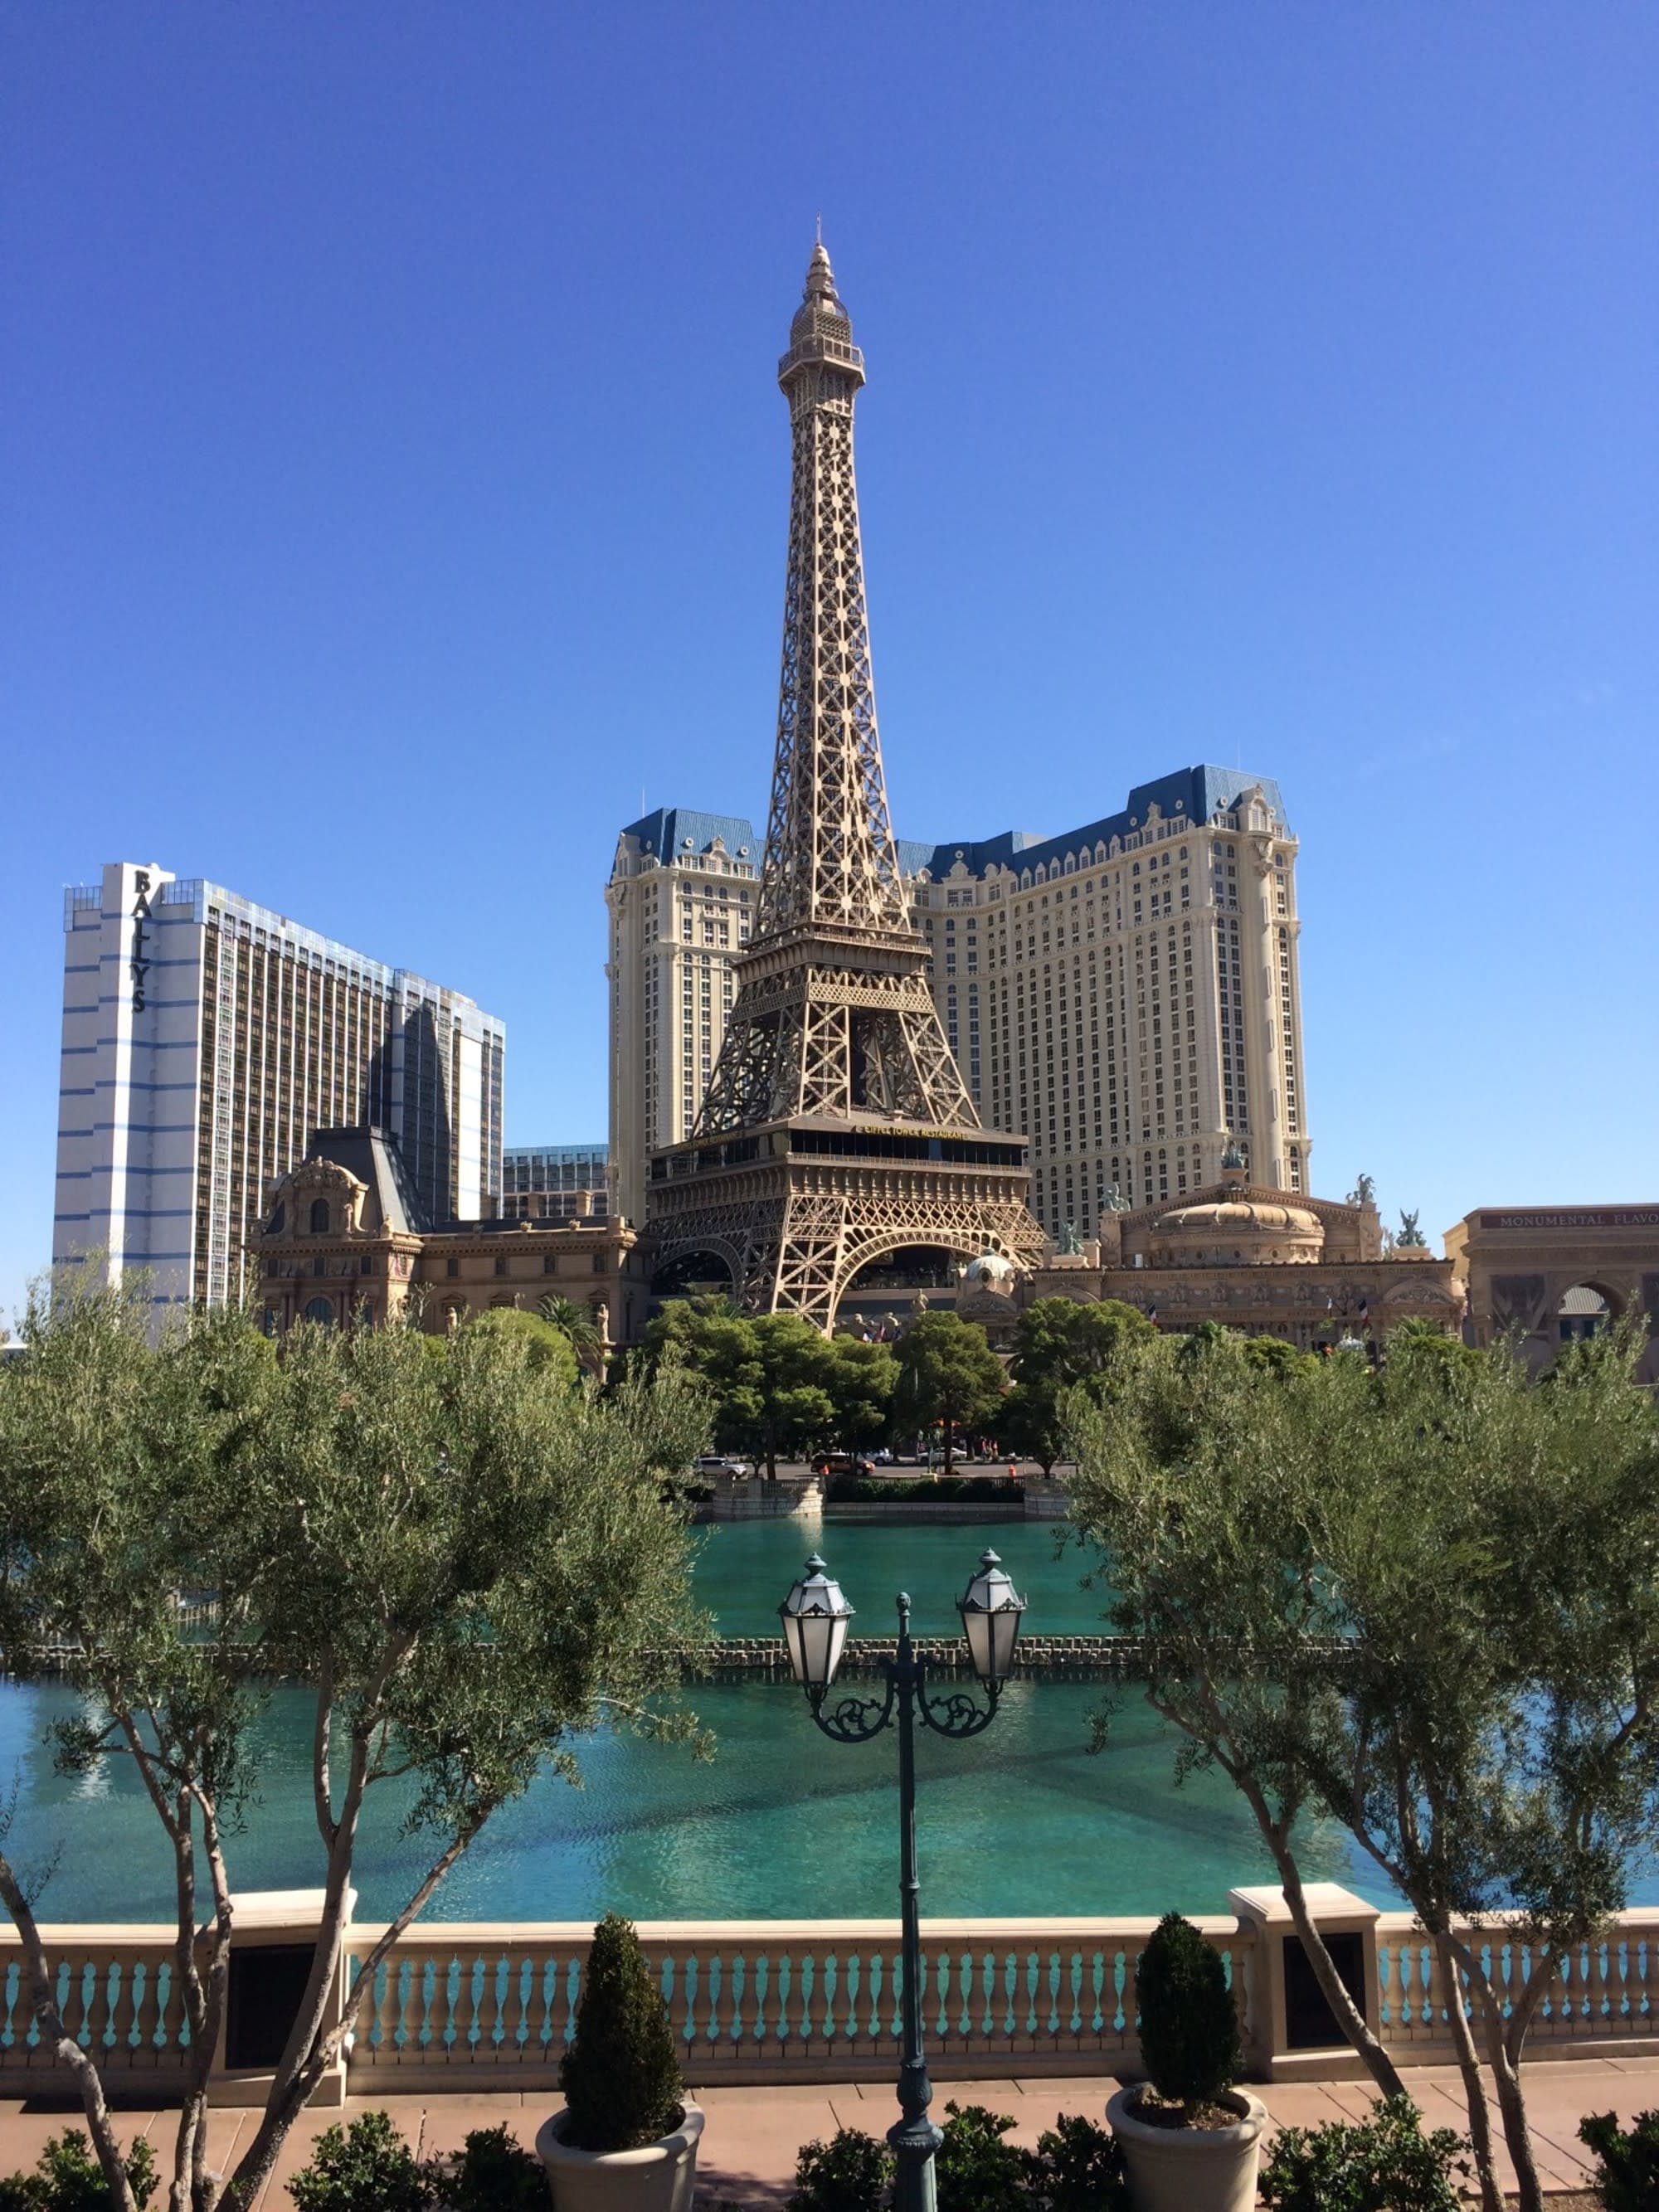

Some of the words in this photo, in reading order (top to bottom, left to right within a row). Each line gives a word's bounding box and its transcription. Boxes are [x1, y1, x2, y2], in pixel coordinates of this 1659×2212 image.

[129, 869, 153, 1014] BALLYS
[864, 1125, 891, 1135] EIFFEL
[891, 1127, 920, 1137] TOWER
[921, 1129, 963, 1140] RESTAURANT
[1500, 1213, 1606, 1228] MONUMENTAL
